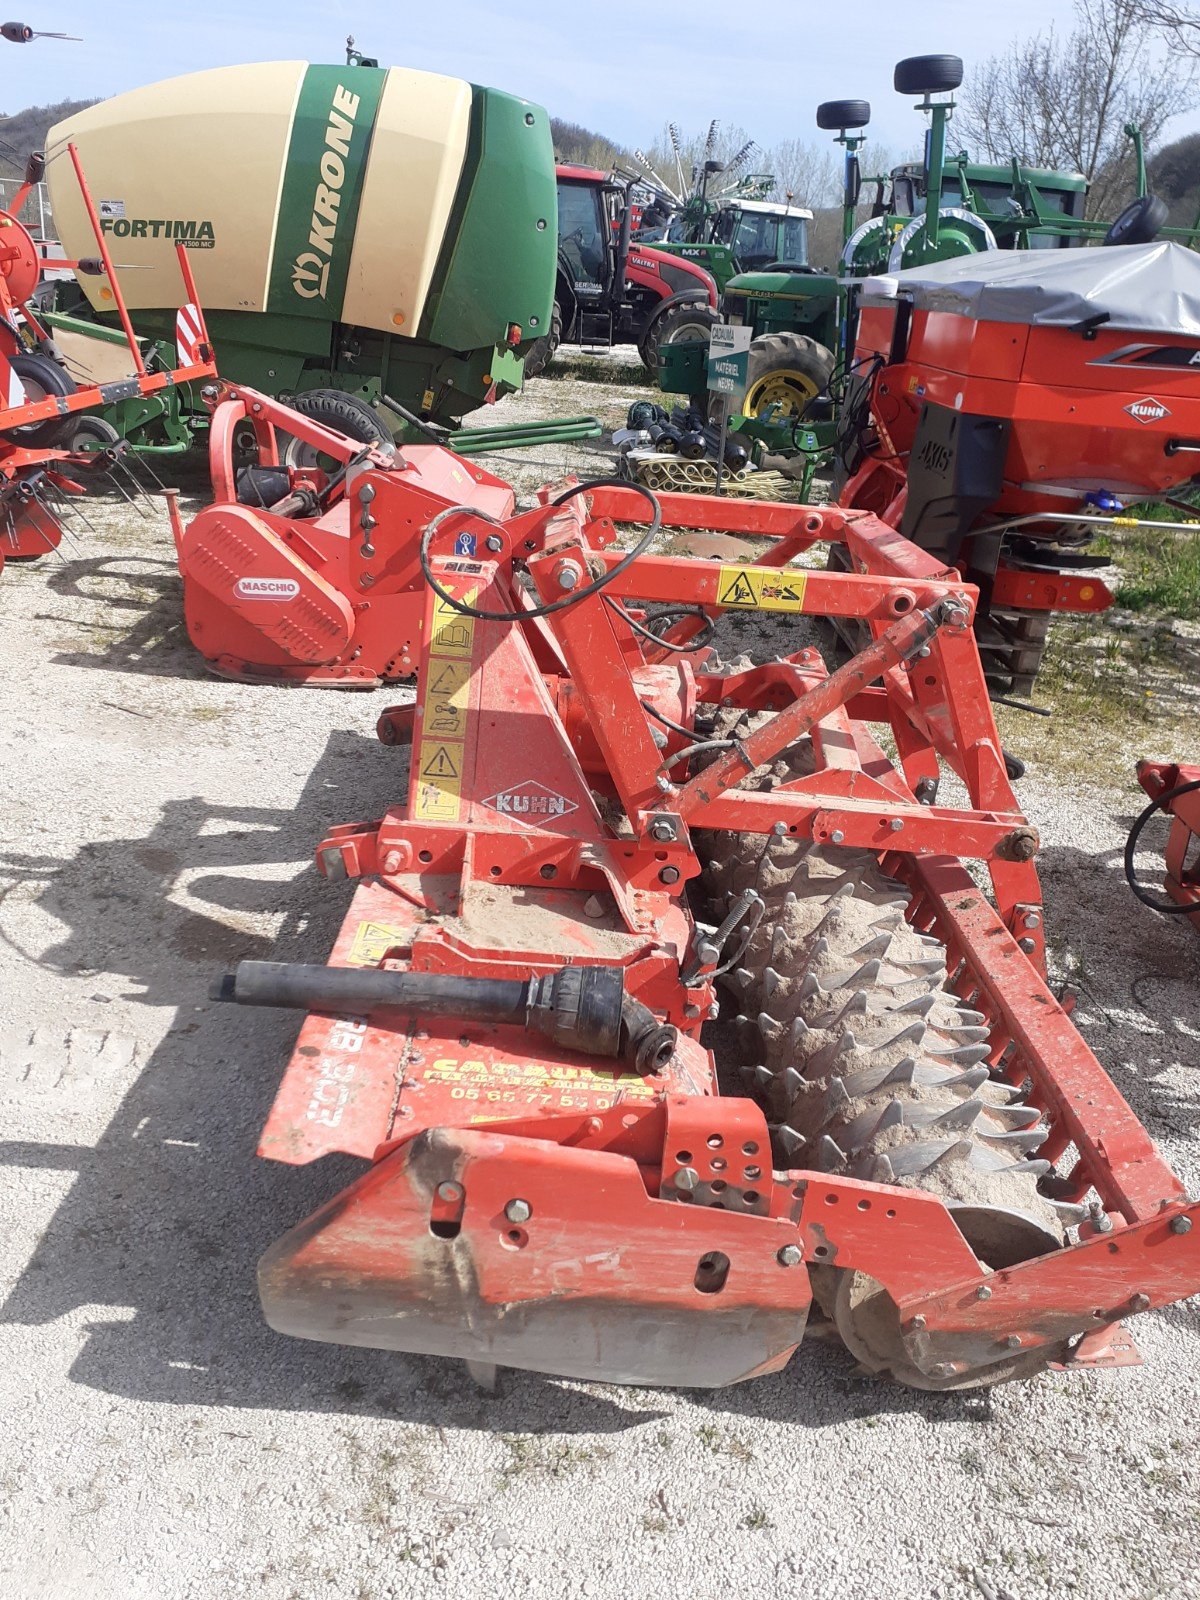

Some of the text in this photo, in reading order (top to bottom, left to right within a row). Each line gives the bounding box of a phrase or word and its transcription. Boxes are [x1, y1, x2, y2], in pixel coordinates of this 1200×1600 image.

[308, 84, 360, 257] KRONE
[99, 218, 215, 239] FORTIMA
[631, 256, 655, 269] VALTRA
[715, 359, 739, 377] MATÉRIEL
[718, 377, 735, 391] NEUFS
[1131, 404, 1165, 417] KUHN
[918, 440, 953, 471] AXIS
[242, 582, 296, 592] MASCHIO
[496, 794, 565, 814] KUHN
[450, 1087, 479, 1100] 05
[486, 1089, 515, 1103] 65
[526, 1092, 552, 1105] 77
